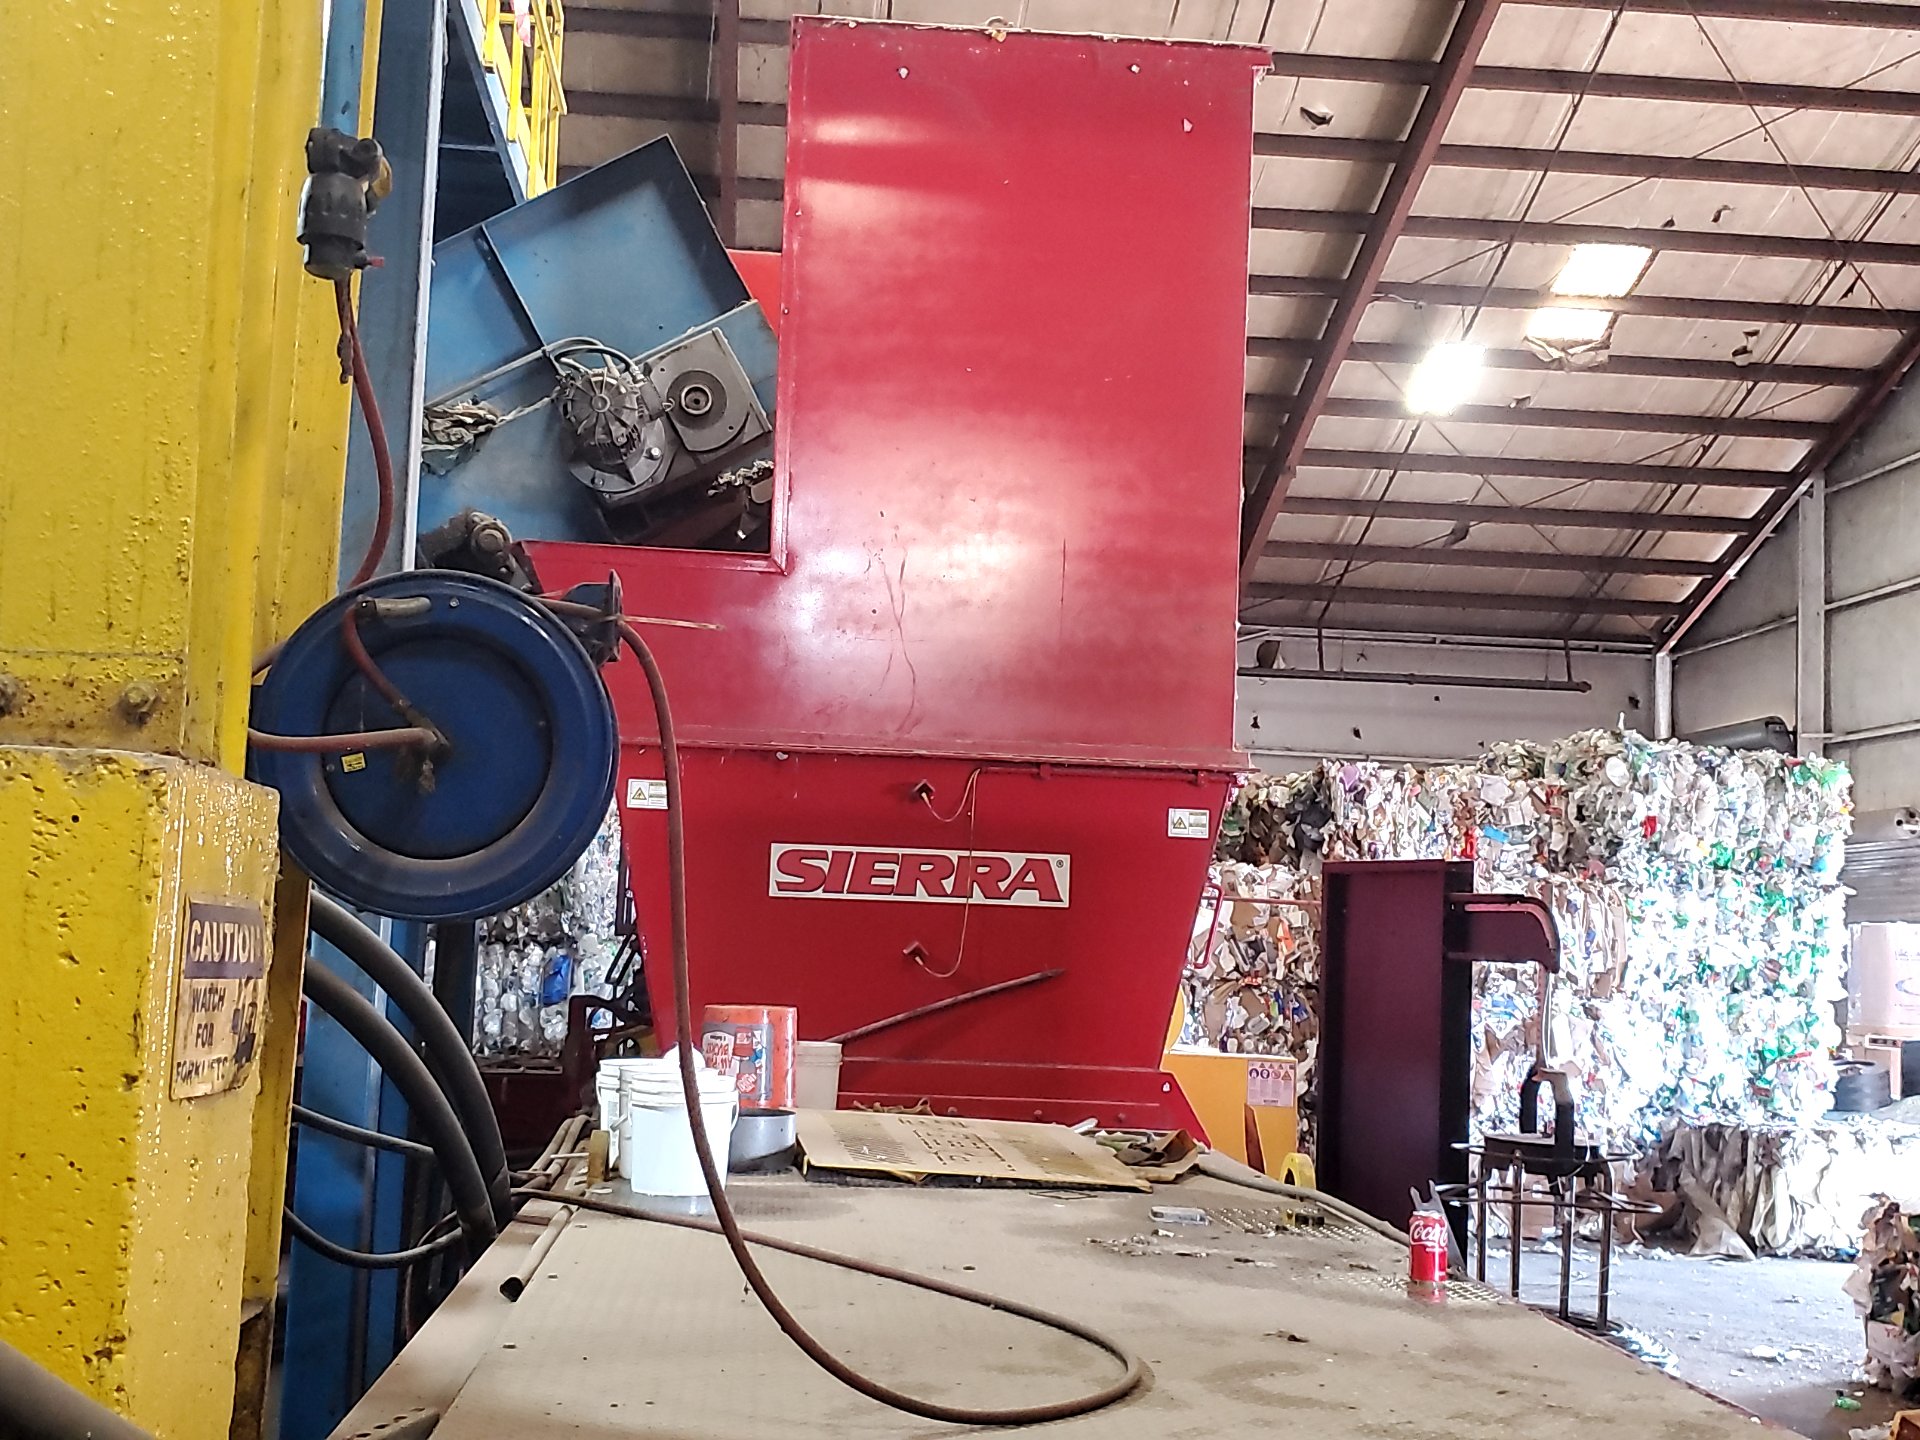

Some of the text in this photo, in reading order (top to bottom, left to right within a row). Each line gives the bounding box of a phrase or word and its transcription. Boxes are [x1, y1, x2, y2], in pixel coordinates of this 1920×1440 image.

[774, 848, 1065, 903] SIERRA
[189, 919, 262, 964] CAUTION
[192, 987, 226, 1013] WATCH
[195, 1022, 214, 1048] FOR
